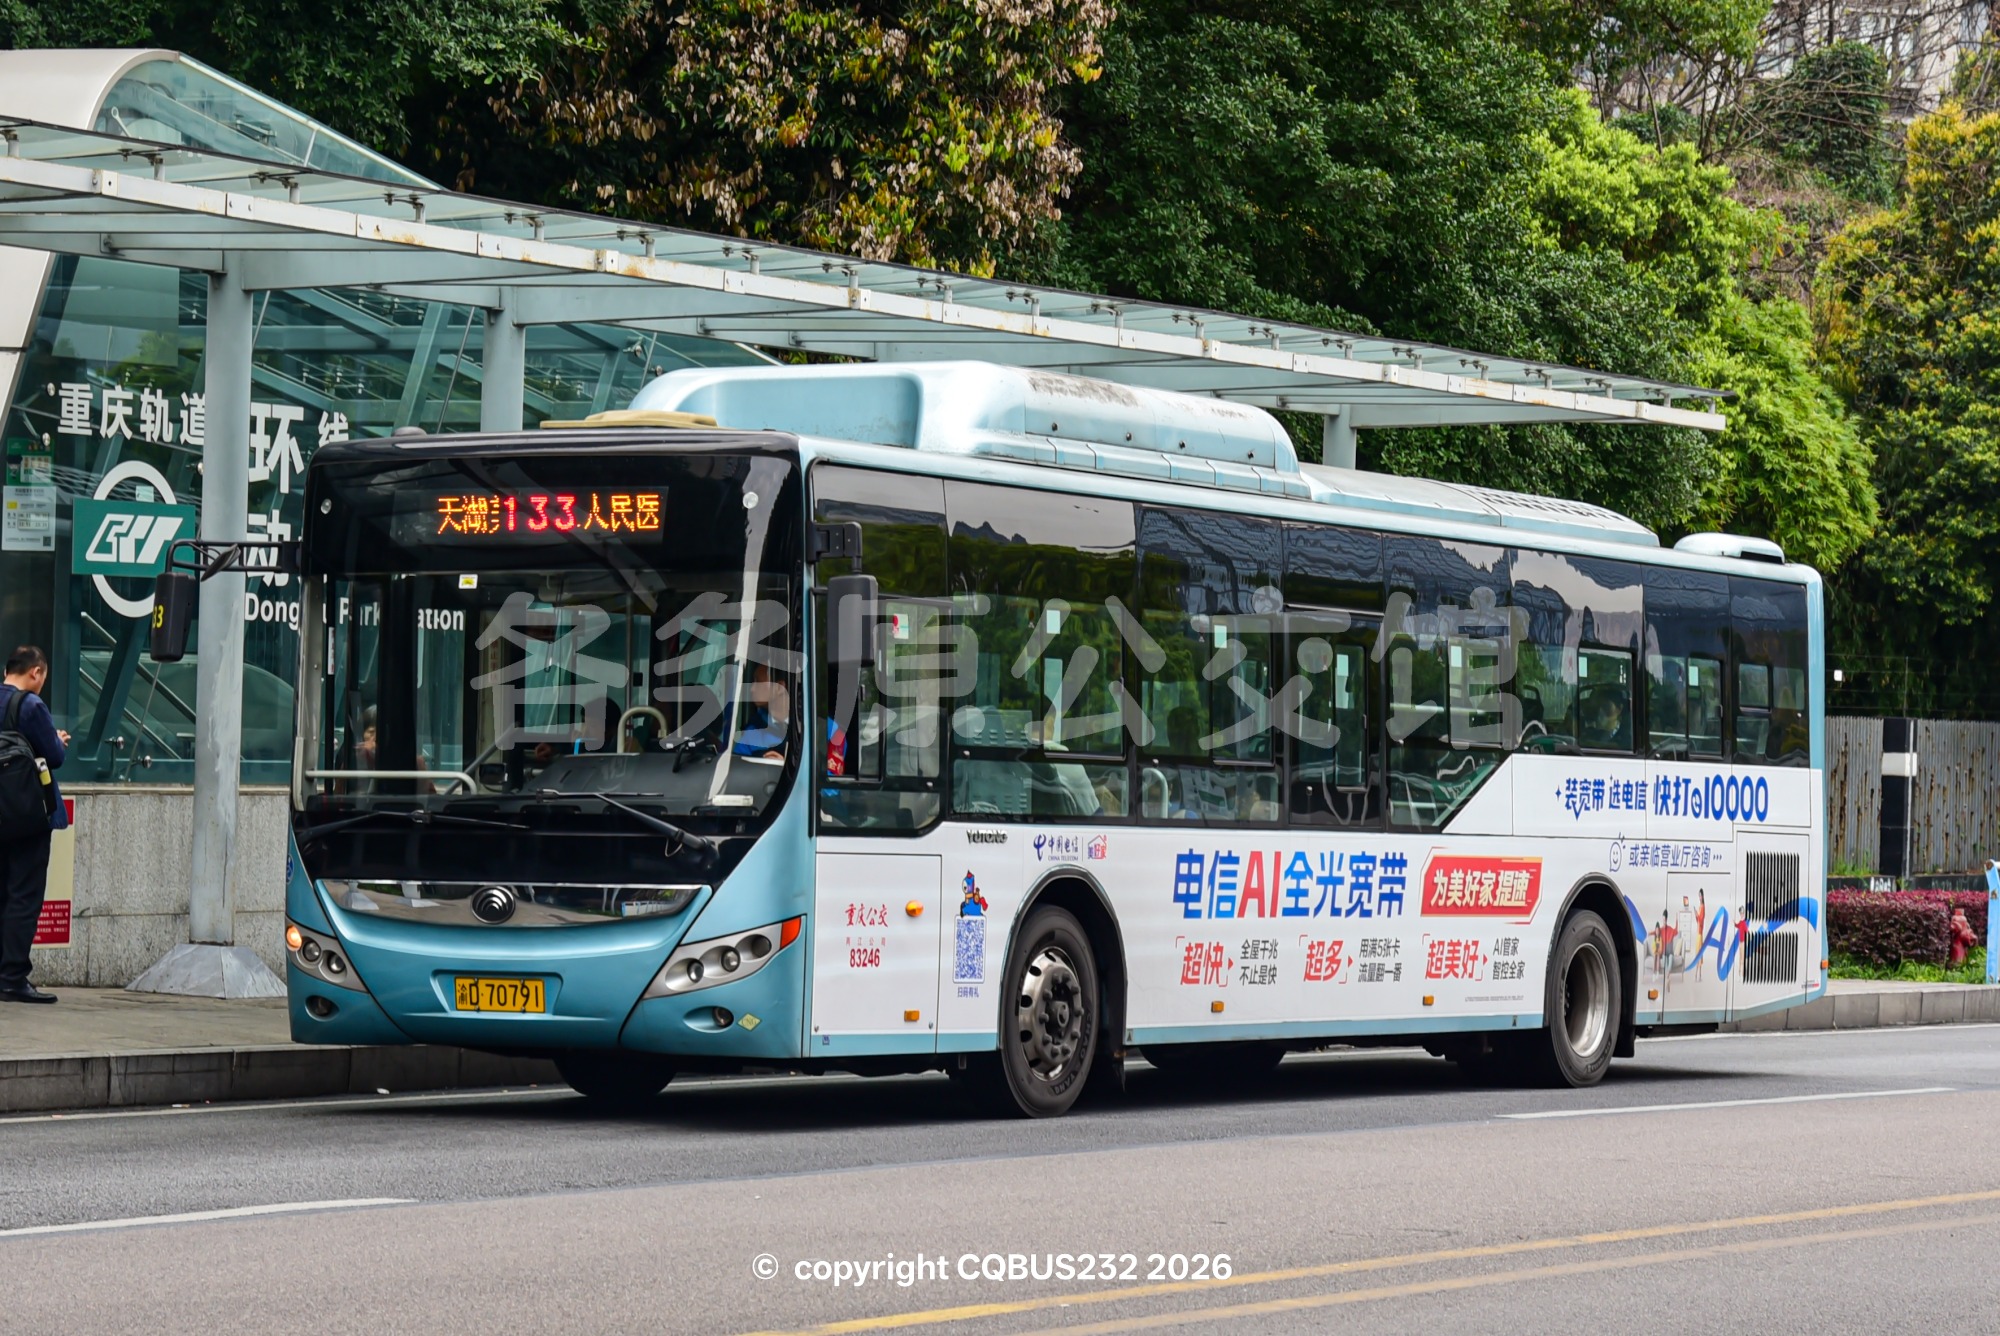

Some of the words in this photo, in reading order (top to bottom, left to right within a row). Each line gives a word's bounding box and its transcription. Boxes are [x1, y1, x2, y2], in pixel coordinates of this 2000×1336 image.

[57, 382, 204, 446] 重庆轨道
[504, 495, 577, 531] 133
[583, 493, 659, 532] 人民医
[1565, 777, 1605, 821] 装宽带
[1609, 779, 1648, 811] 选电信
[1048, 835, 1079, 854] 中国电信
[1628, 844, 1711, 868] 或亲临营业厅咨询
[1172, 848, 1408, 919] 电信AI全光宽带
[1430, 868, 1533, 908] 为美好家提速
[845, 903, 888, 928] 重庆公交
[850, 948, 880, 968] 83246
[1240, 939, 1278, 960] 全屋千兆
[1359, 938, 1400, 958] 用满5张卡
[1493, 937, 1519, 956] AI管家
[1180, 941, 1224, 985] 超快
[1303, 940, 1344, 982] 超多
[1425, 940, 1479, 980] 超美好
[1493, 961, 1525, 980] 智控全家
[1239, 965, 1277, 986] 不止是快
[1358, 962, 1402, 983] 流量翻一番
